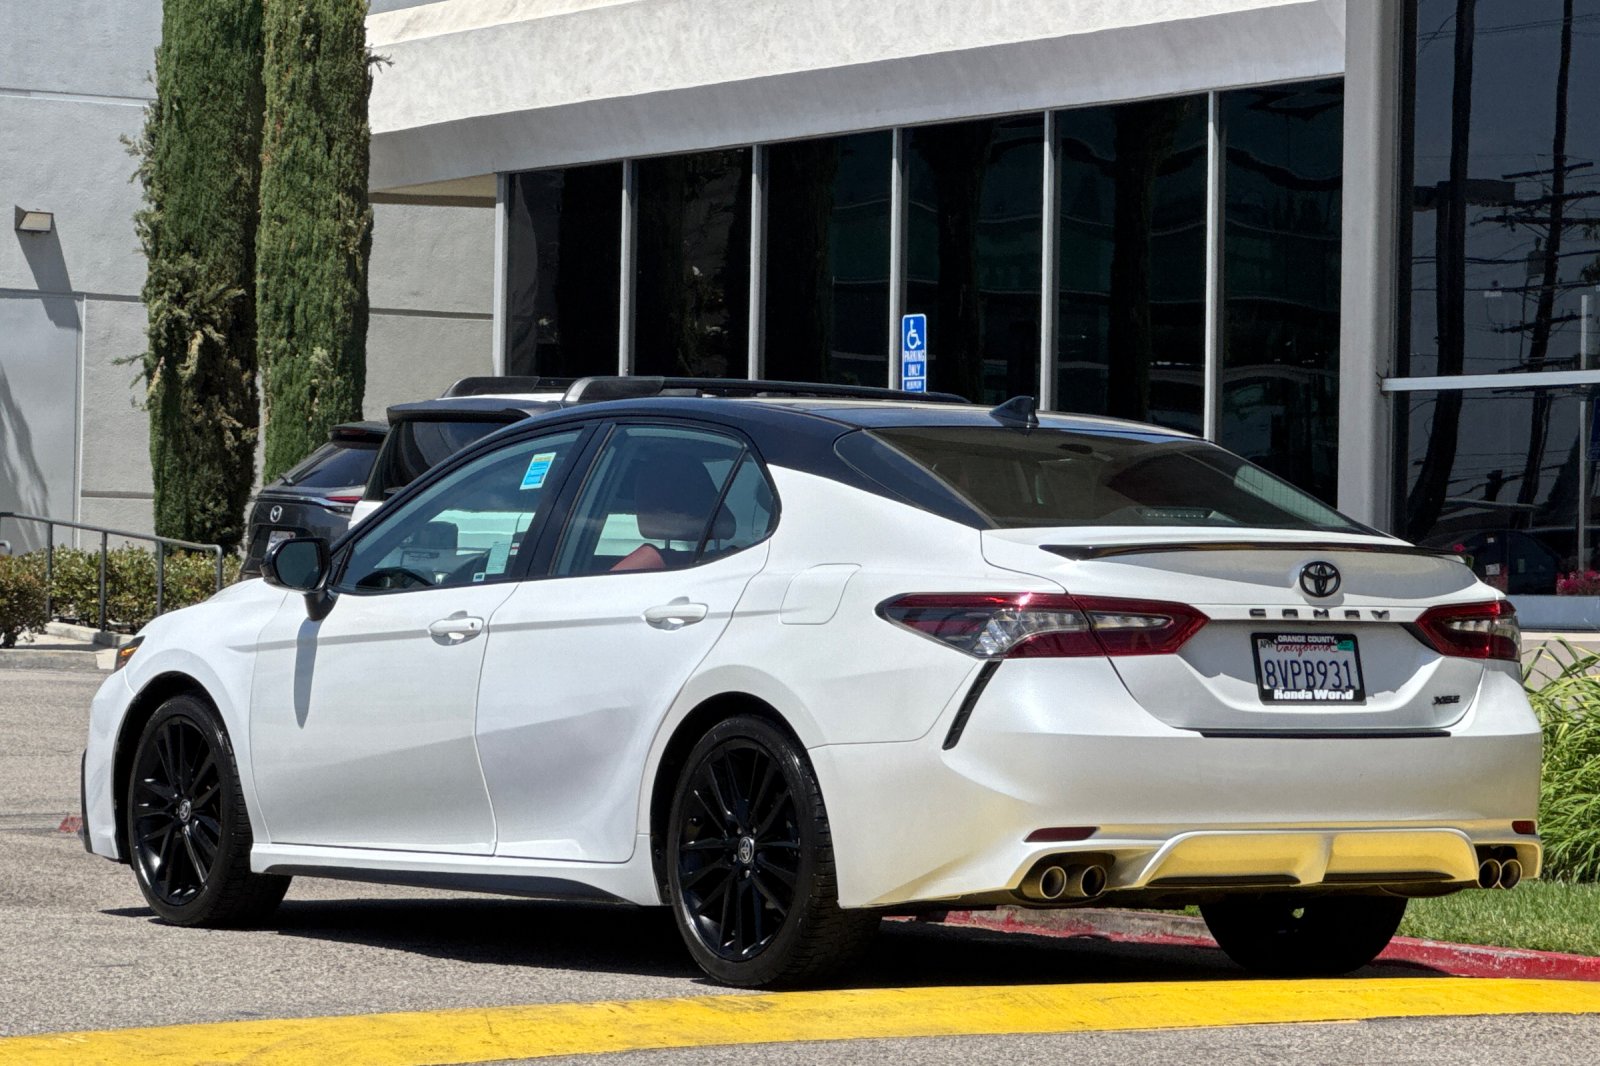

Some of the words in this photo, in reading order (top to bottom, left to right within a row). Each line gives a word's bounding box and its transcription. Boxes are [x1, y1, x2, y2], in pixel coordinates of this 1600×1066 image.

[904, 350, 925, 362] PARKING
[907, 364, 921, 376] ONLY
[1249, 608, 1390, 618] CAMRY
[1277, 635, 1306, 643] ORANGE
[1307, 635, 1335, 643] COUNTY
[1264, 660, 1355, 689] 8VPB931
[1274, 690, 1313, 700] Honda
